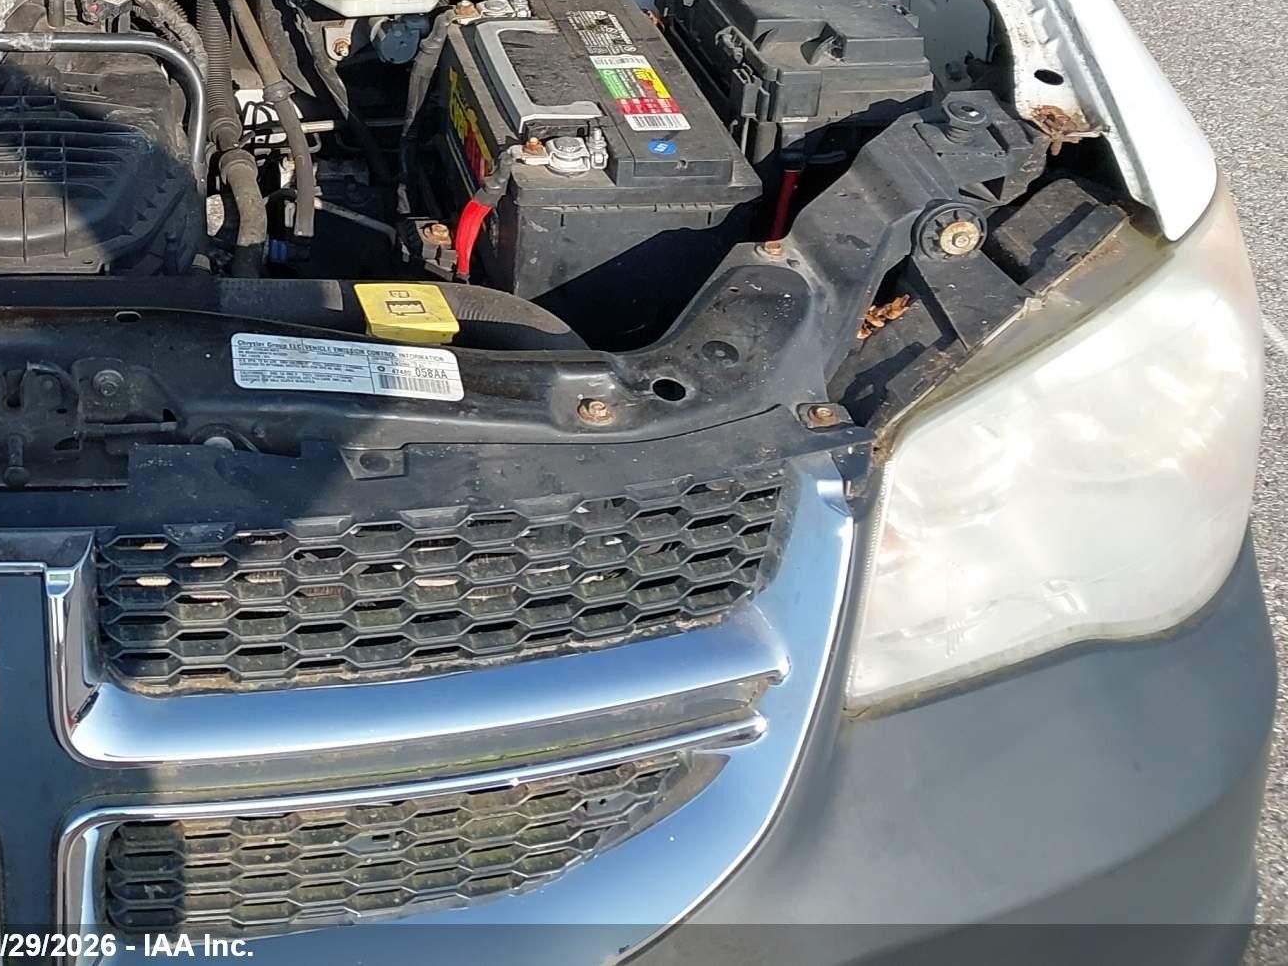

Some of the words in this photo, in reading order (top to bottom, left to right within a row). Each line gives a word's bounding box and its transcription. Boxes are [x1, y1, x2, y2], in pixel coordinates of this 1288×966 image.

[237, 339, 265, 348] Chrysler
[267, 341, 287, 350] Group
[305, 344, 331, 352] VEHICLE
[333, 346, 365, 355] EMISSION
[367, 350, 396, 358] CONTROL
[398, 353, 444, 361] INFORMATION
[415, 367, 448, 379] 058AA
